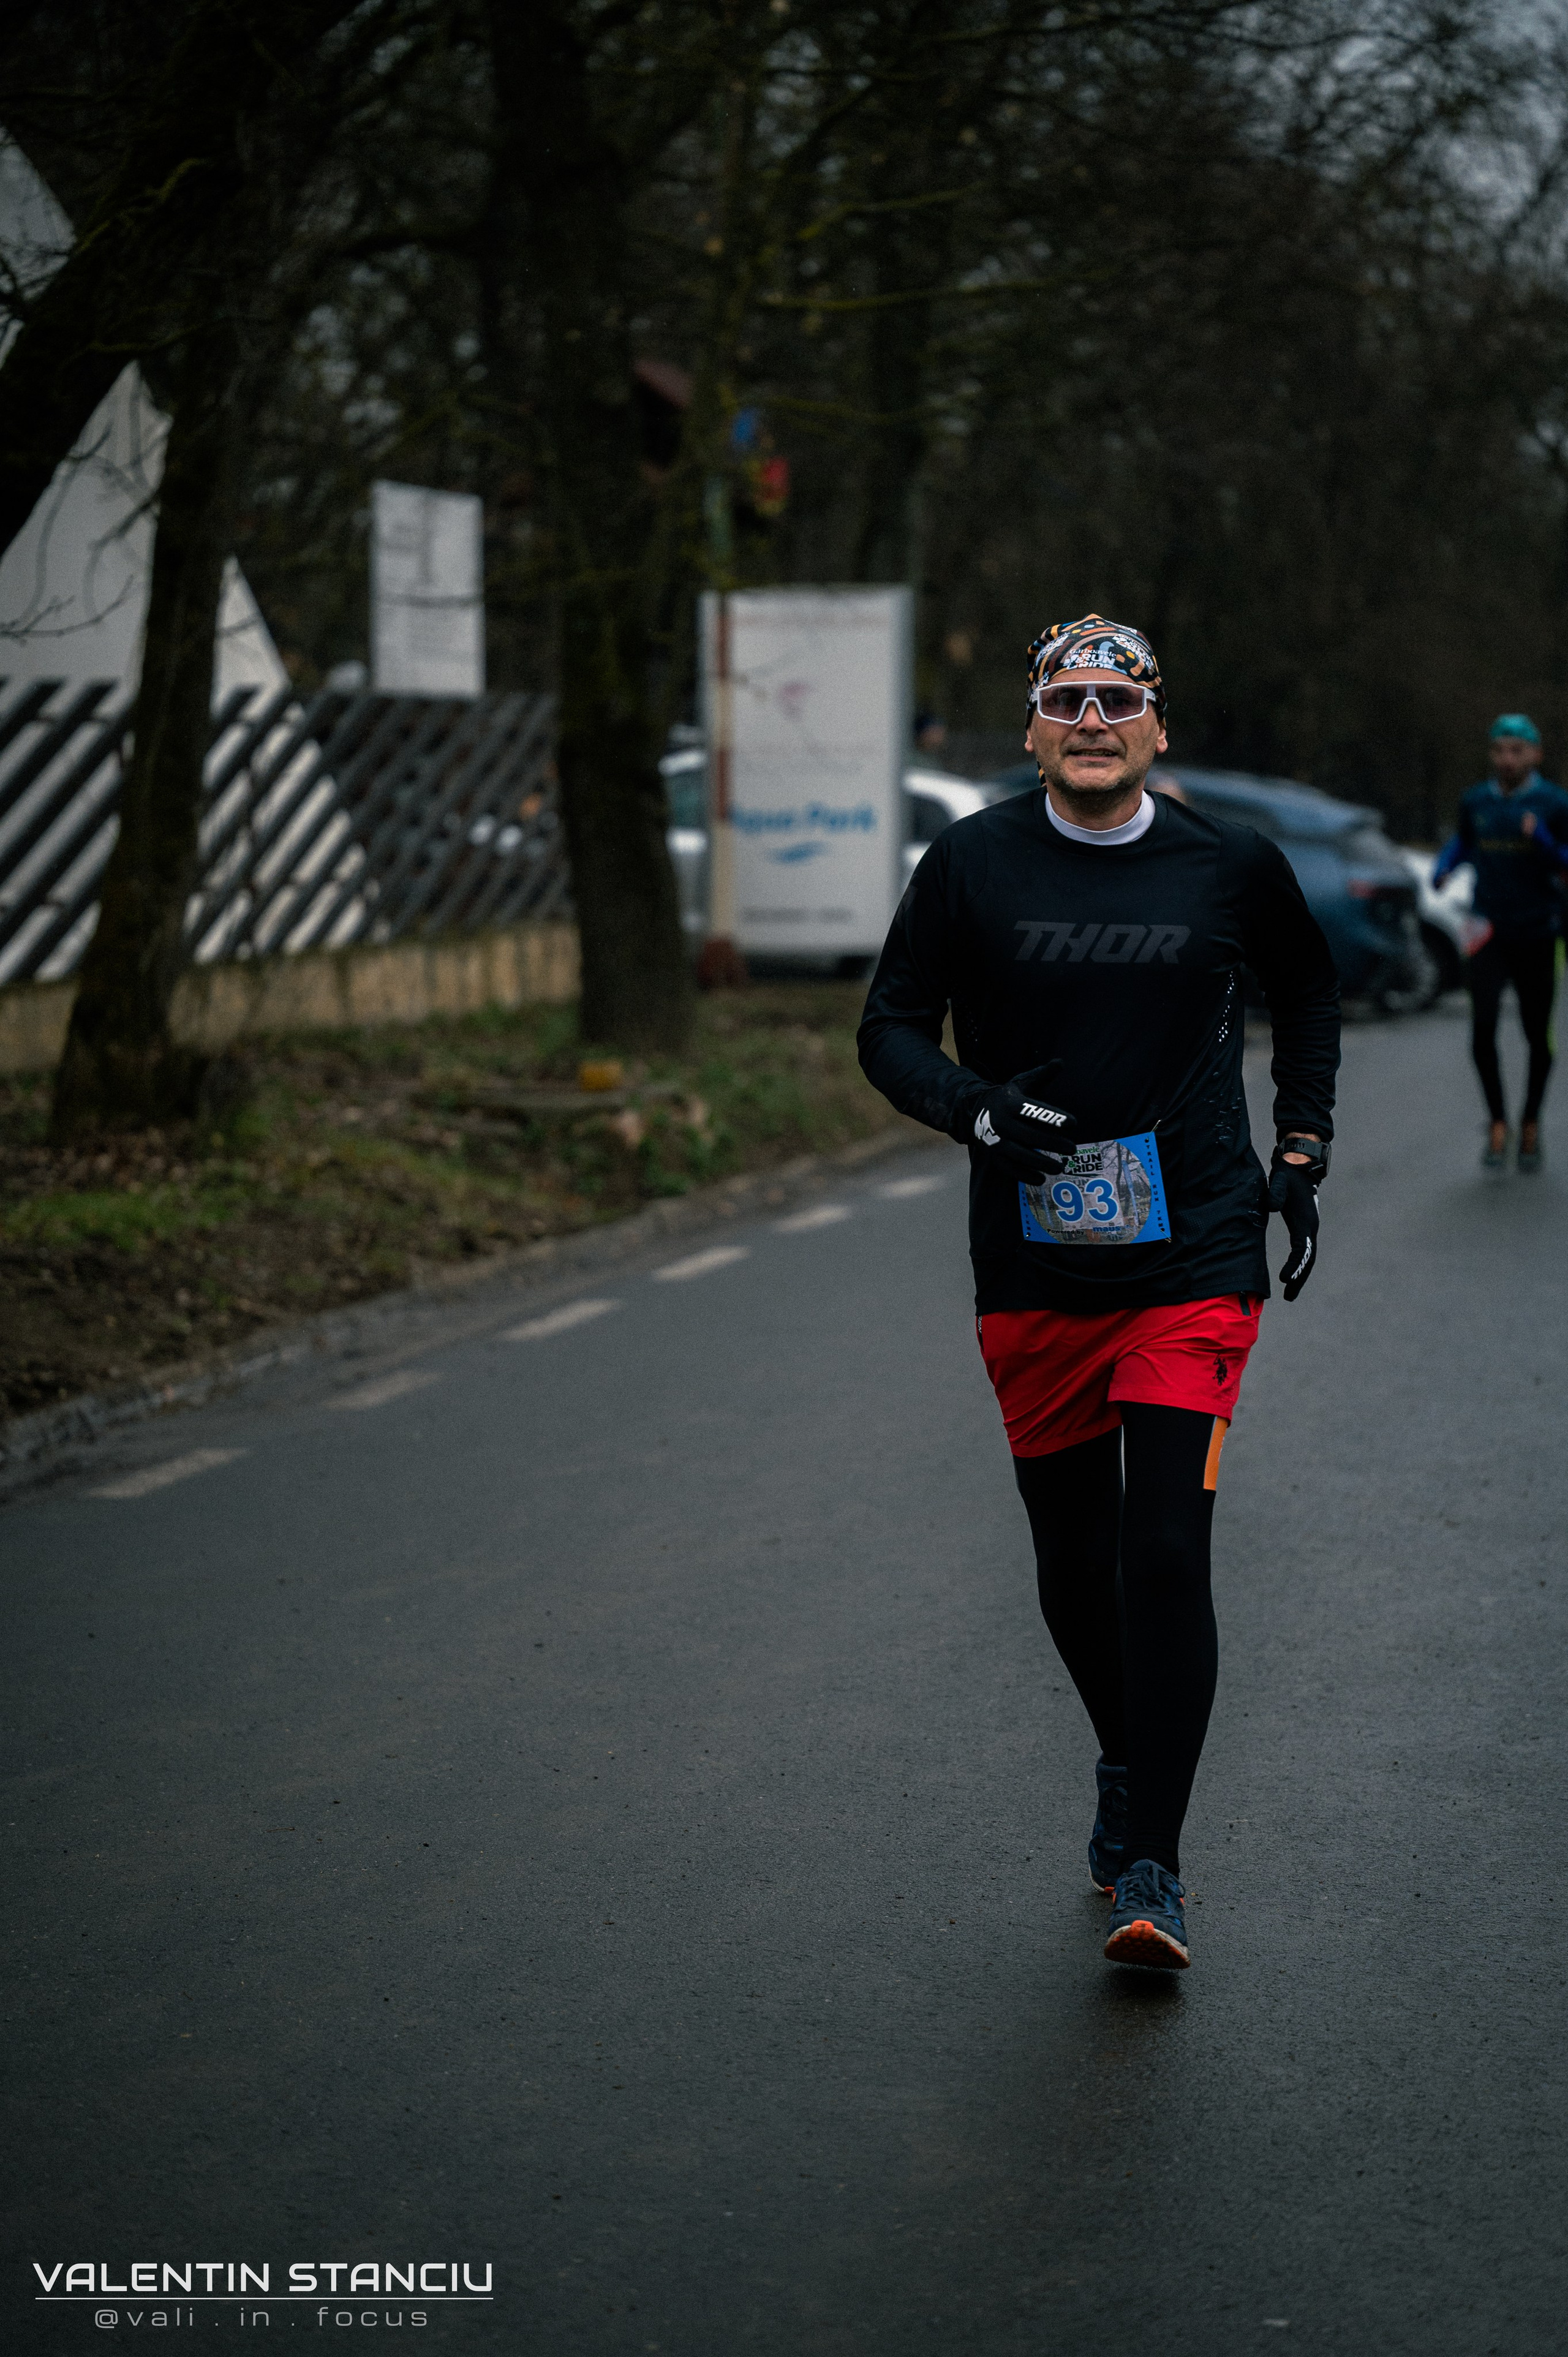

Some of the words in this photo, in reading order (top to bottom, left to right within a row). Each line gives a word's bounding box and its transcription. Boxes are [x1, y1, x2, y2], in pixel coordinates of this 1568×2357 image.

[1069, 648, 1117, 658] Garboavele
[1082, 653, 1115, 665] RUN
[1014, 920, 1192, 964] THOR
[1019, 1102, 1067, 1127] THOR
[1071, 1153, 1102, 1164] RUN
[1146, 1145, 1155, 1175] TRAIL
[1072, 1163, 1103, 1173] RIDE
[1052, 1179, 1118, 1223] 93
